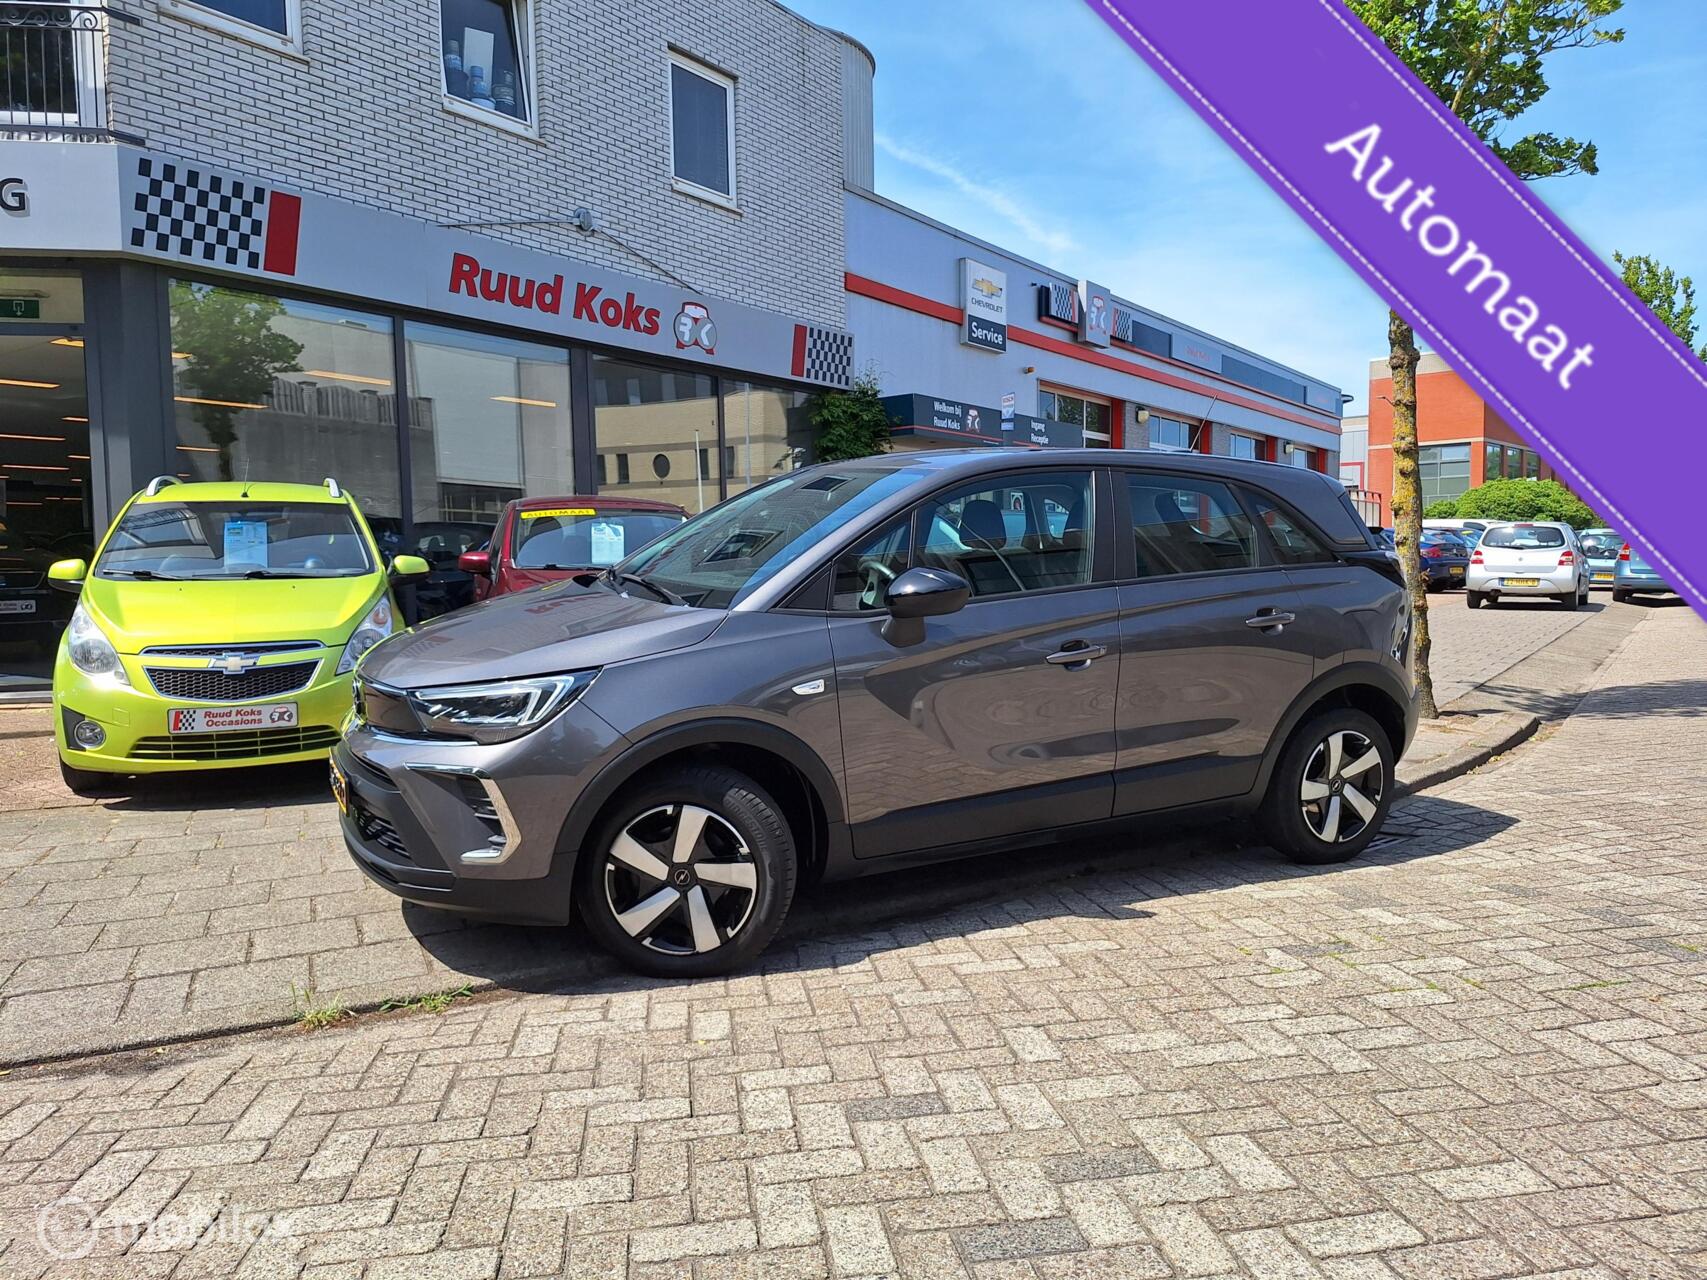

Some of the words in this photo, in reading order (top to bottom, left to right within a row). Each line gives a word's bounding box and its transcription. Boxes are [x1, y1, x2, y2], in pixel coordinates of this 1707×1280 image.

[448, 252, 564, 315] Ruud
[573, 282, 661, 336] Koks
[971, 297, 1003, 313] CHEVROLET
[971, 321, 1003, 345] Service
[933, 400, 954, 414] Welkom
[954, 404, 962, 418] bij
[933, 415, 947, 428] Ruud
[947, 418, 961, 430] Koks
[1030, 419, 1045, 433] Ingang
[1030, 432, 1049, 446] Receptie
[204, 709, 232, 719] Ruud
[235, 708, 263, 717] Koks
[205, 717, 263, 727] Occasions
